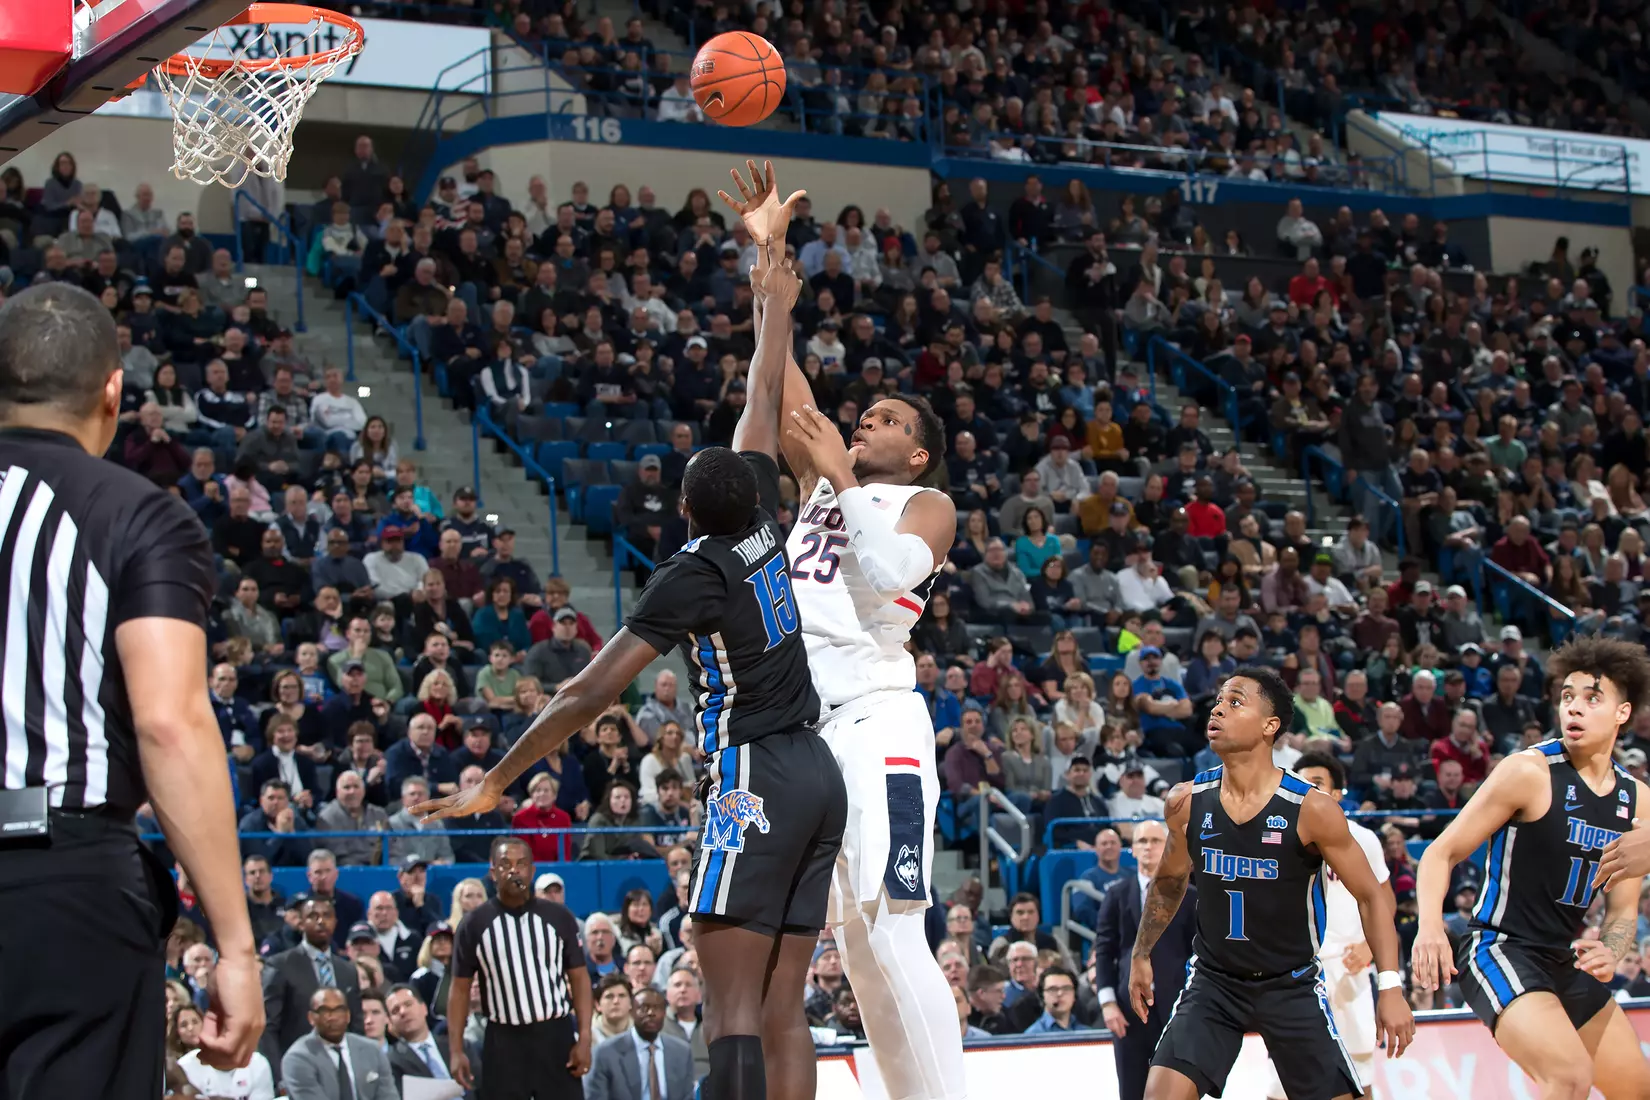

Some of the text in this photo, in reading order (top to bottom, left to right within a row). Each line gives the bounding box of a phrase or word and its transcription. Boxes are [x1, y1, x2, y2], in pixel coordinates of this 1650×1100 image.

[571, 116, 622, 143] 116
[1179, 179, 1218, 204] 117
[800, 502, 846, 532] UCO
[732, 524, 776, 567] THOMAS
[790, 532, 850, 584] 25
[744, 551, 799, 652] 15
[1201, 847, 1279, 881] Tigers
[1556, 857, 1600, 908] 11
[1224, 889, 1250, 941] 1
